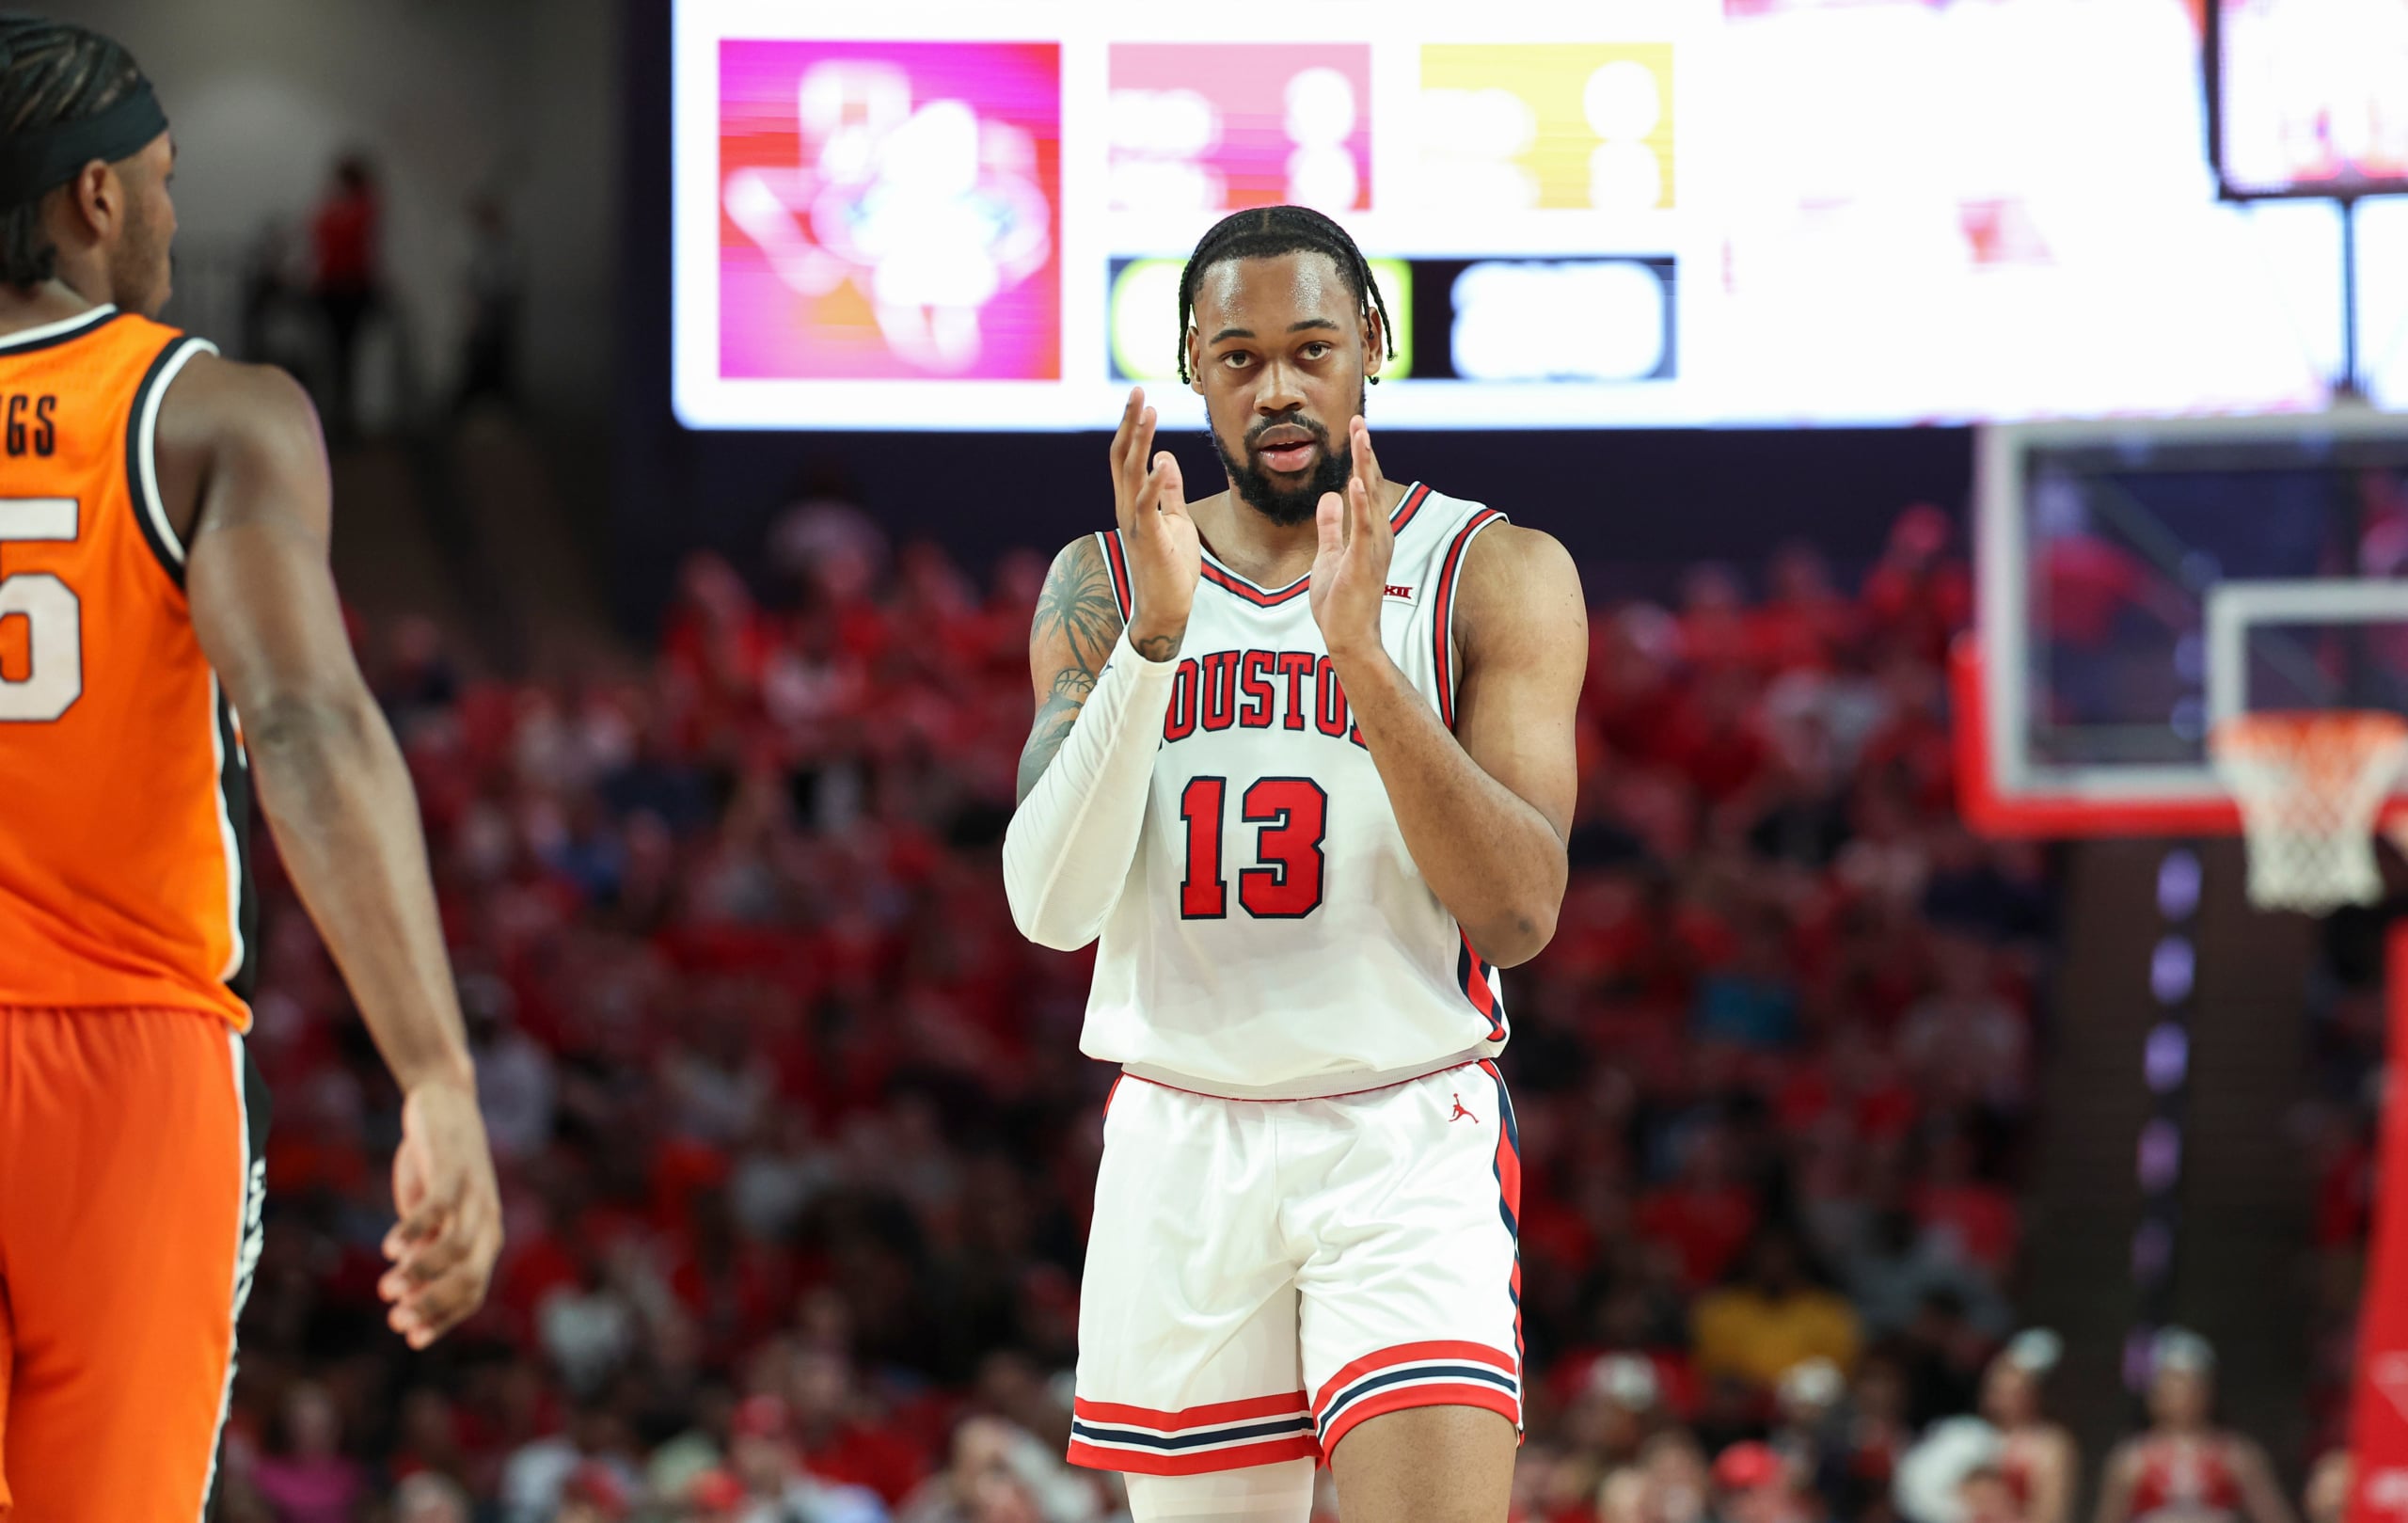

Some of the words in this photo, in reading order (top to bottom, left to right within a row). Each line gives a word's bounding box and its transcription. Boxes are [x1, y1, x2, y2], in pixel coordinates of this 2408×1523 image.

[0, 395, 56, 456] GS
[1159, 649, 1369, 751] OUSTO
[1180, 775, 1328, 920] 13
